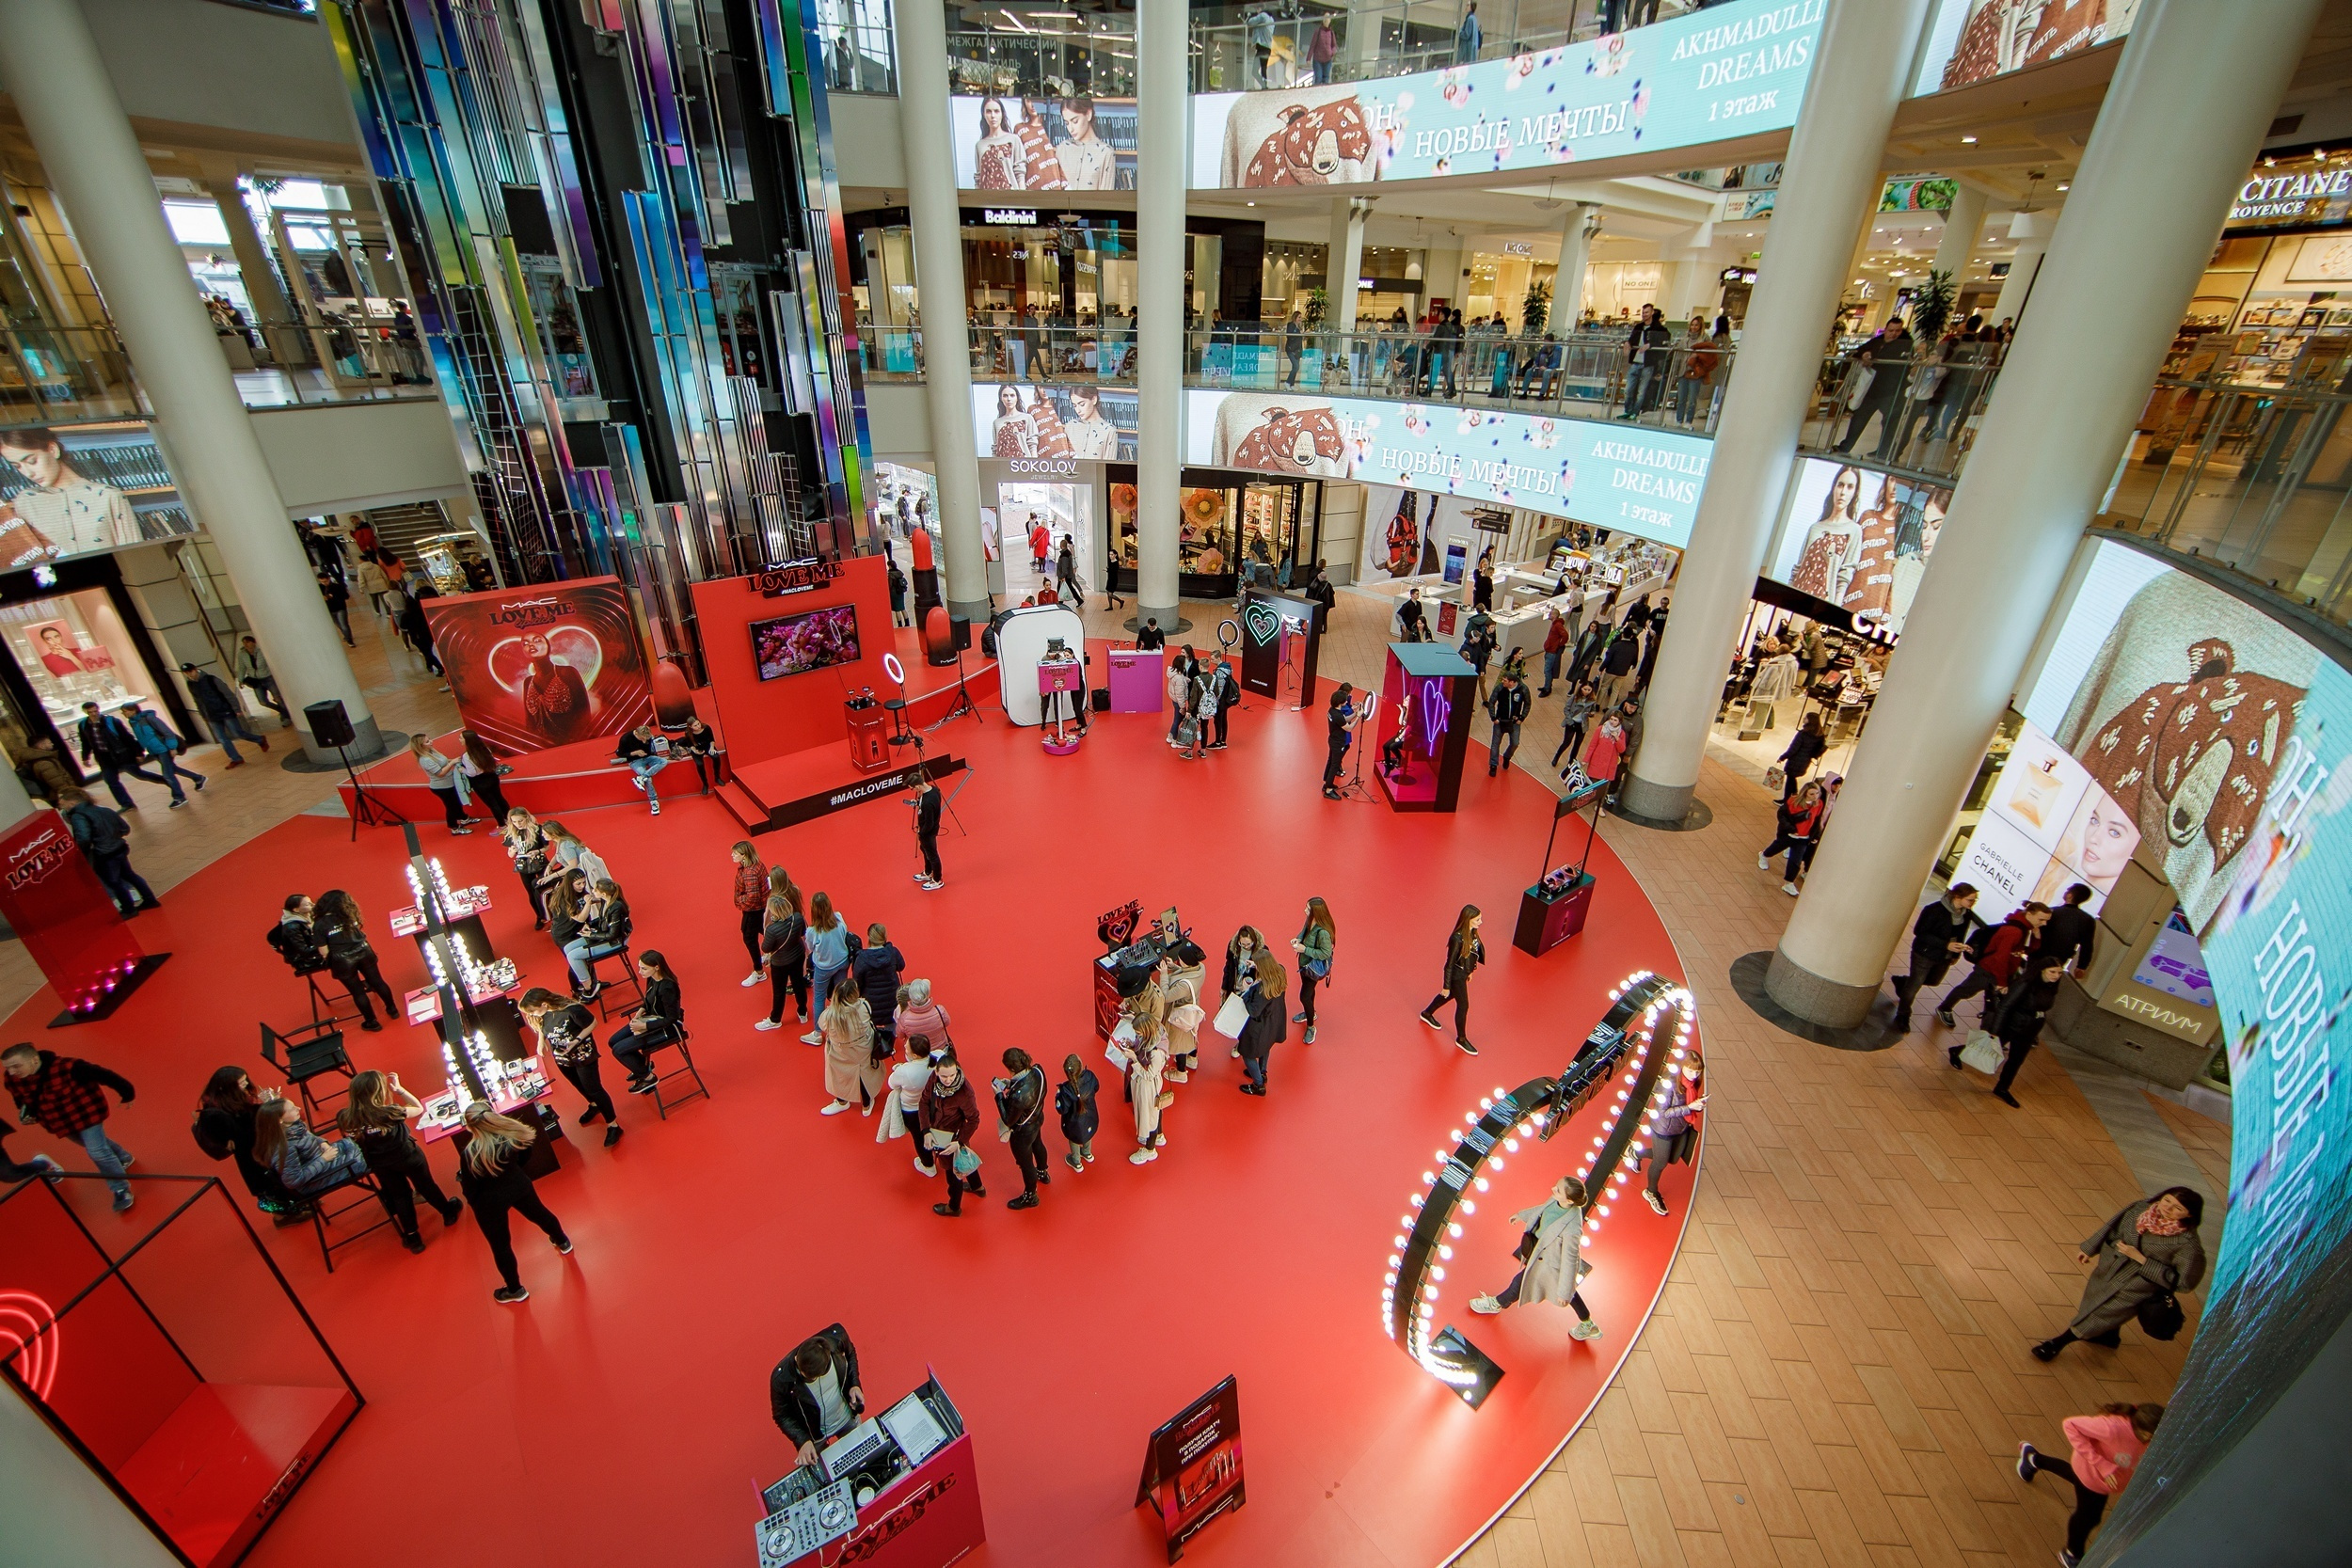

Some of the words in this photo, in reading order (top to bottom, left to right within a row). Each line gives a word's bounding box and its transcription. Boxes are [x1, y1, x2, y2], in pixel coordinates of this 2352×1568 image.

[1696, 35, 1812, 91] DREAMS
[1708, 102, 1718, 122] 1
[1722, 89, 1780, 119] этаж
[1413, 119, 1512, 158] НОВЫЕ
[1517, 100, 1630, 148] МЕЧТЫ
[985, 210, 1037, 225] Baldinini
[1010, 460, 1076, 473] SOKOLOV
[1381, 448, 1462, 479] НОВЫЕ
[1468, 459, 1559, 496] МЕЧТЫ
[1611, 467, 1696, 504] DREAMS
[1620, 501, 1629, 516] 1
[1630, 505, 1675, 527] этаж
[745, 567, 810, 593] LOVE
[810, 562, 846, 583] ME
[1565, 555, 1587, 570] WOW
[781, 584, 814, 595] #MACLOVEME
[1867, 574, 1893, 585] МЕЧТАТЬ
[488, 607, 541, 626] LOVE
[545, 602, 576, 616] ME
[1851, 613, 1900, 647] CH
[830, 774, 903, 806] #MACLOVEME
[5, 849, 51, 891] LOVE
[46, 834, 75, 861] ME
[1974, 855, 2015, 896] CHANEL
[1979, 842, 2025, 882] GABRIELLE
[1096, 906, 1124, 926] LOVE
[1125, 898, 1139, 914] ME
[2114, 994, 2202, 1035] АТРИУМ
[2254, 897, 2330, 1172] НОВЫЕ
[1179, 1433, 1202, 1454] ПОЛУЧИ
[1202, 1418, 1220, 1435] КЛАТЧ
[1188, 1429, 1216, 1451] ПОДАРОК
[1181, 1453, 1193, 1465] ПРИ
[910, 1472, 958, 1511] ME
